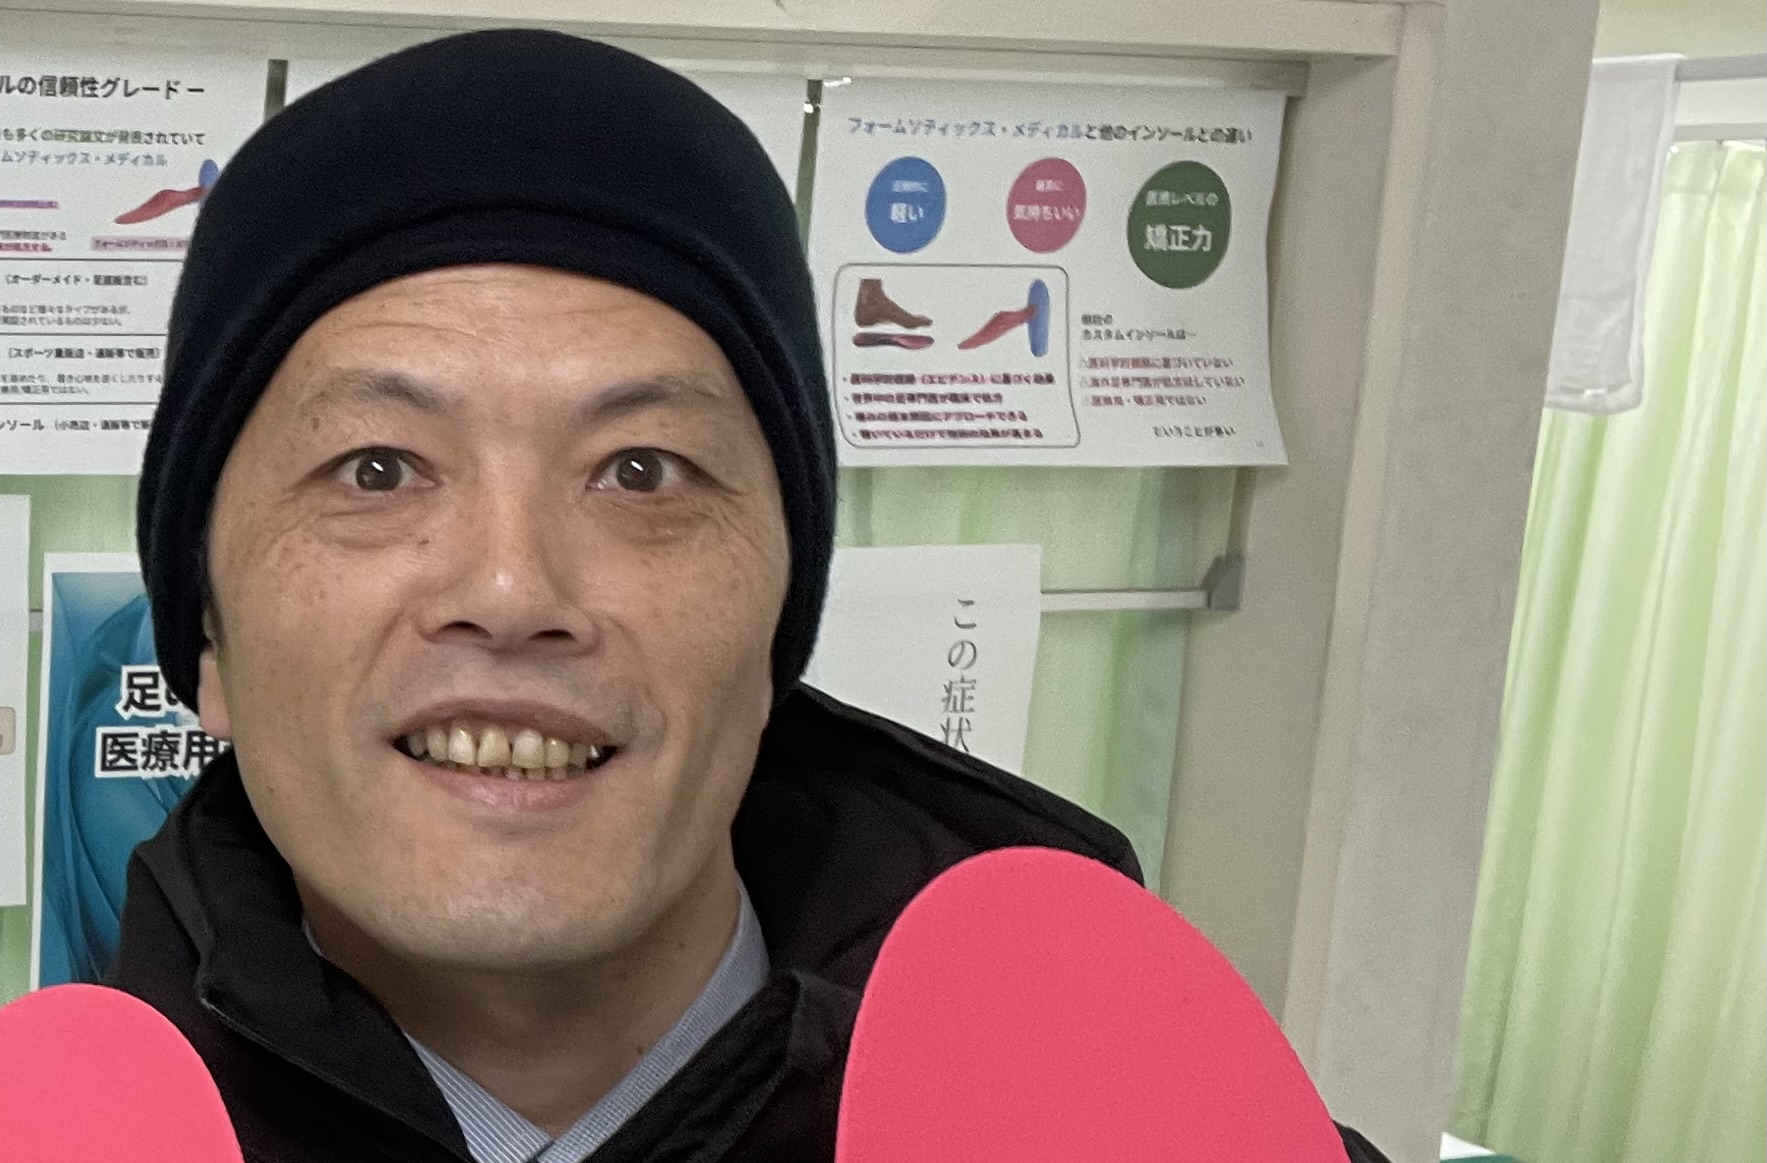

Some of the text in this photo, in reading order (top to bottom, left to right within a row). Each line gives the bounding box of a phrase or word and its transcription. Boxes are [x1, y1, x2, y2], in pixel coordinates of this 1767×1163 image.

[890, 203, 924, 223] 軽い
[1013, 204, 1080, 221] 気持ちいい
[1145, 223, 1213, 253] 矯正力
[940, 598, 978, 752] この症状
[100, 730, 217, 773] 医療用
